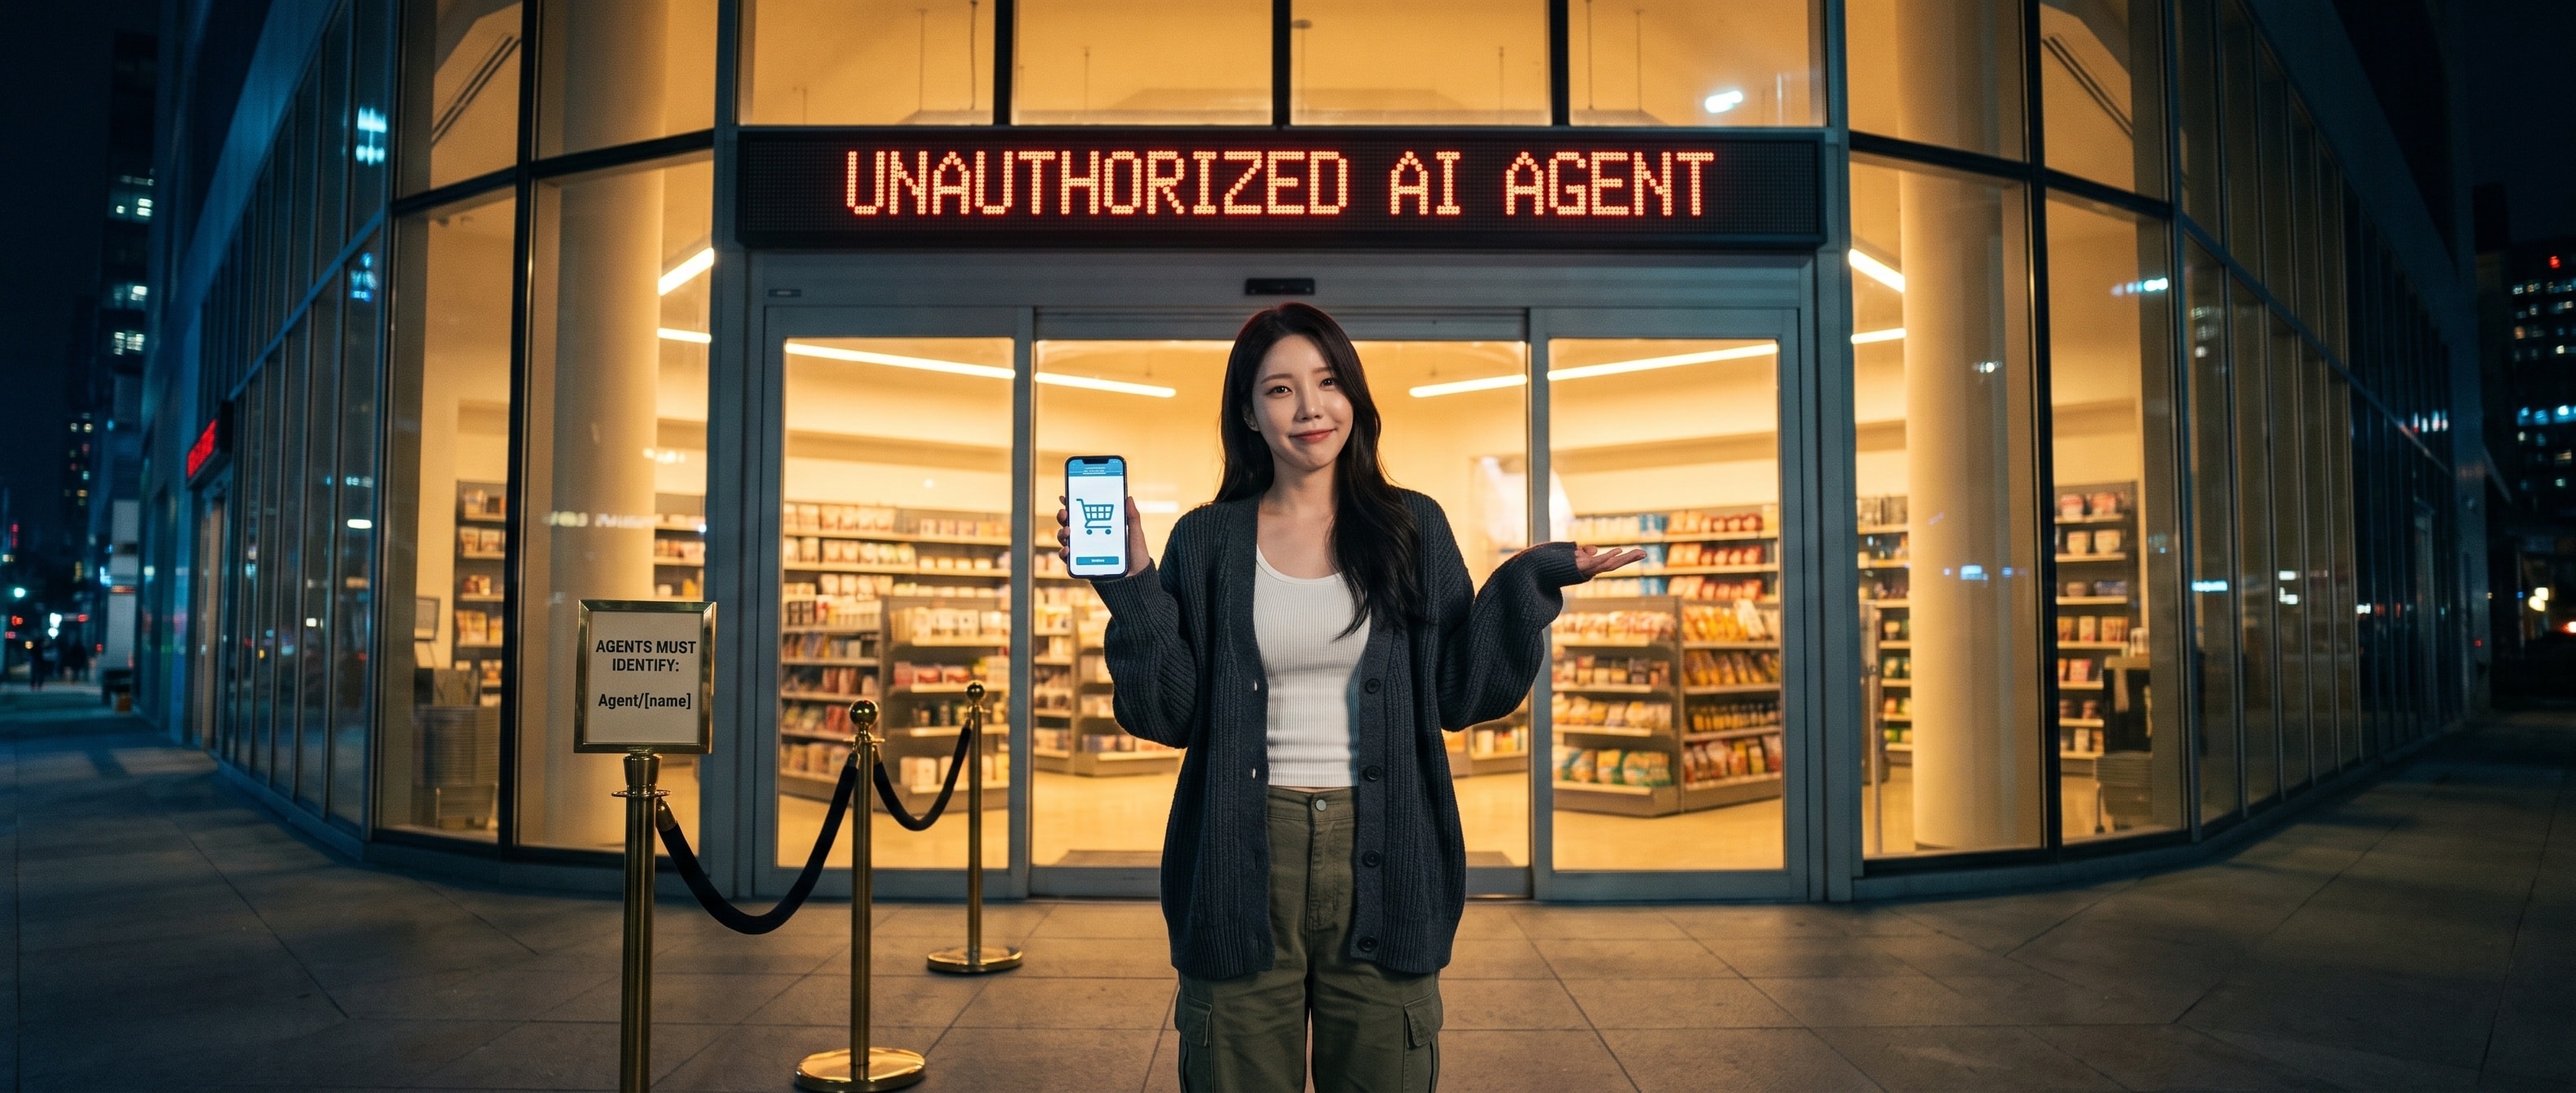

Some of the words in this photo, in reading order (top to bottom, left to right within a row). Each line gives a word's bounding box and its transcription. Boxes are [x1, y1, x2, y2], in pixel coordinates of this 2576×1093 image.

[846, 150, 1347, 216] UNAUTHORIZED
[1389, 150, 1460, 216] AI
[1504, 151, 1714, 216] AGENT
[595, 639, 652, 654] AGENTS
[656, 641, 696, 654] MUST
[612, 658, 680, 672] IDENTIFY:
[598, 693, 691, 709] Agent/[name]
